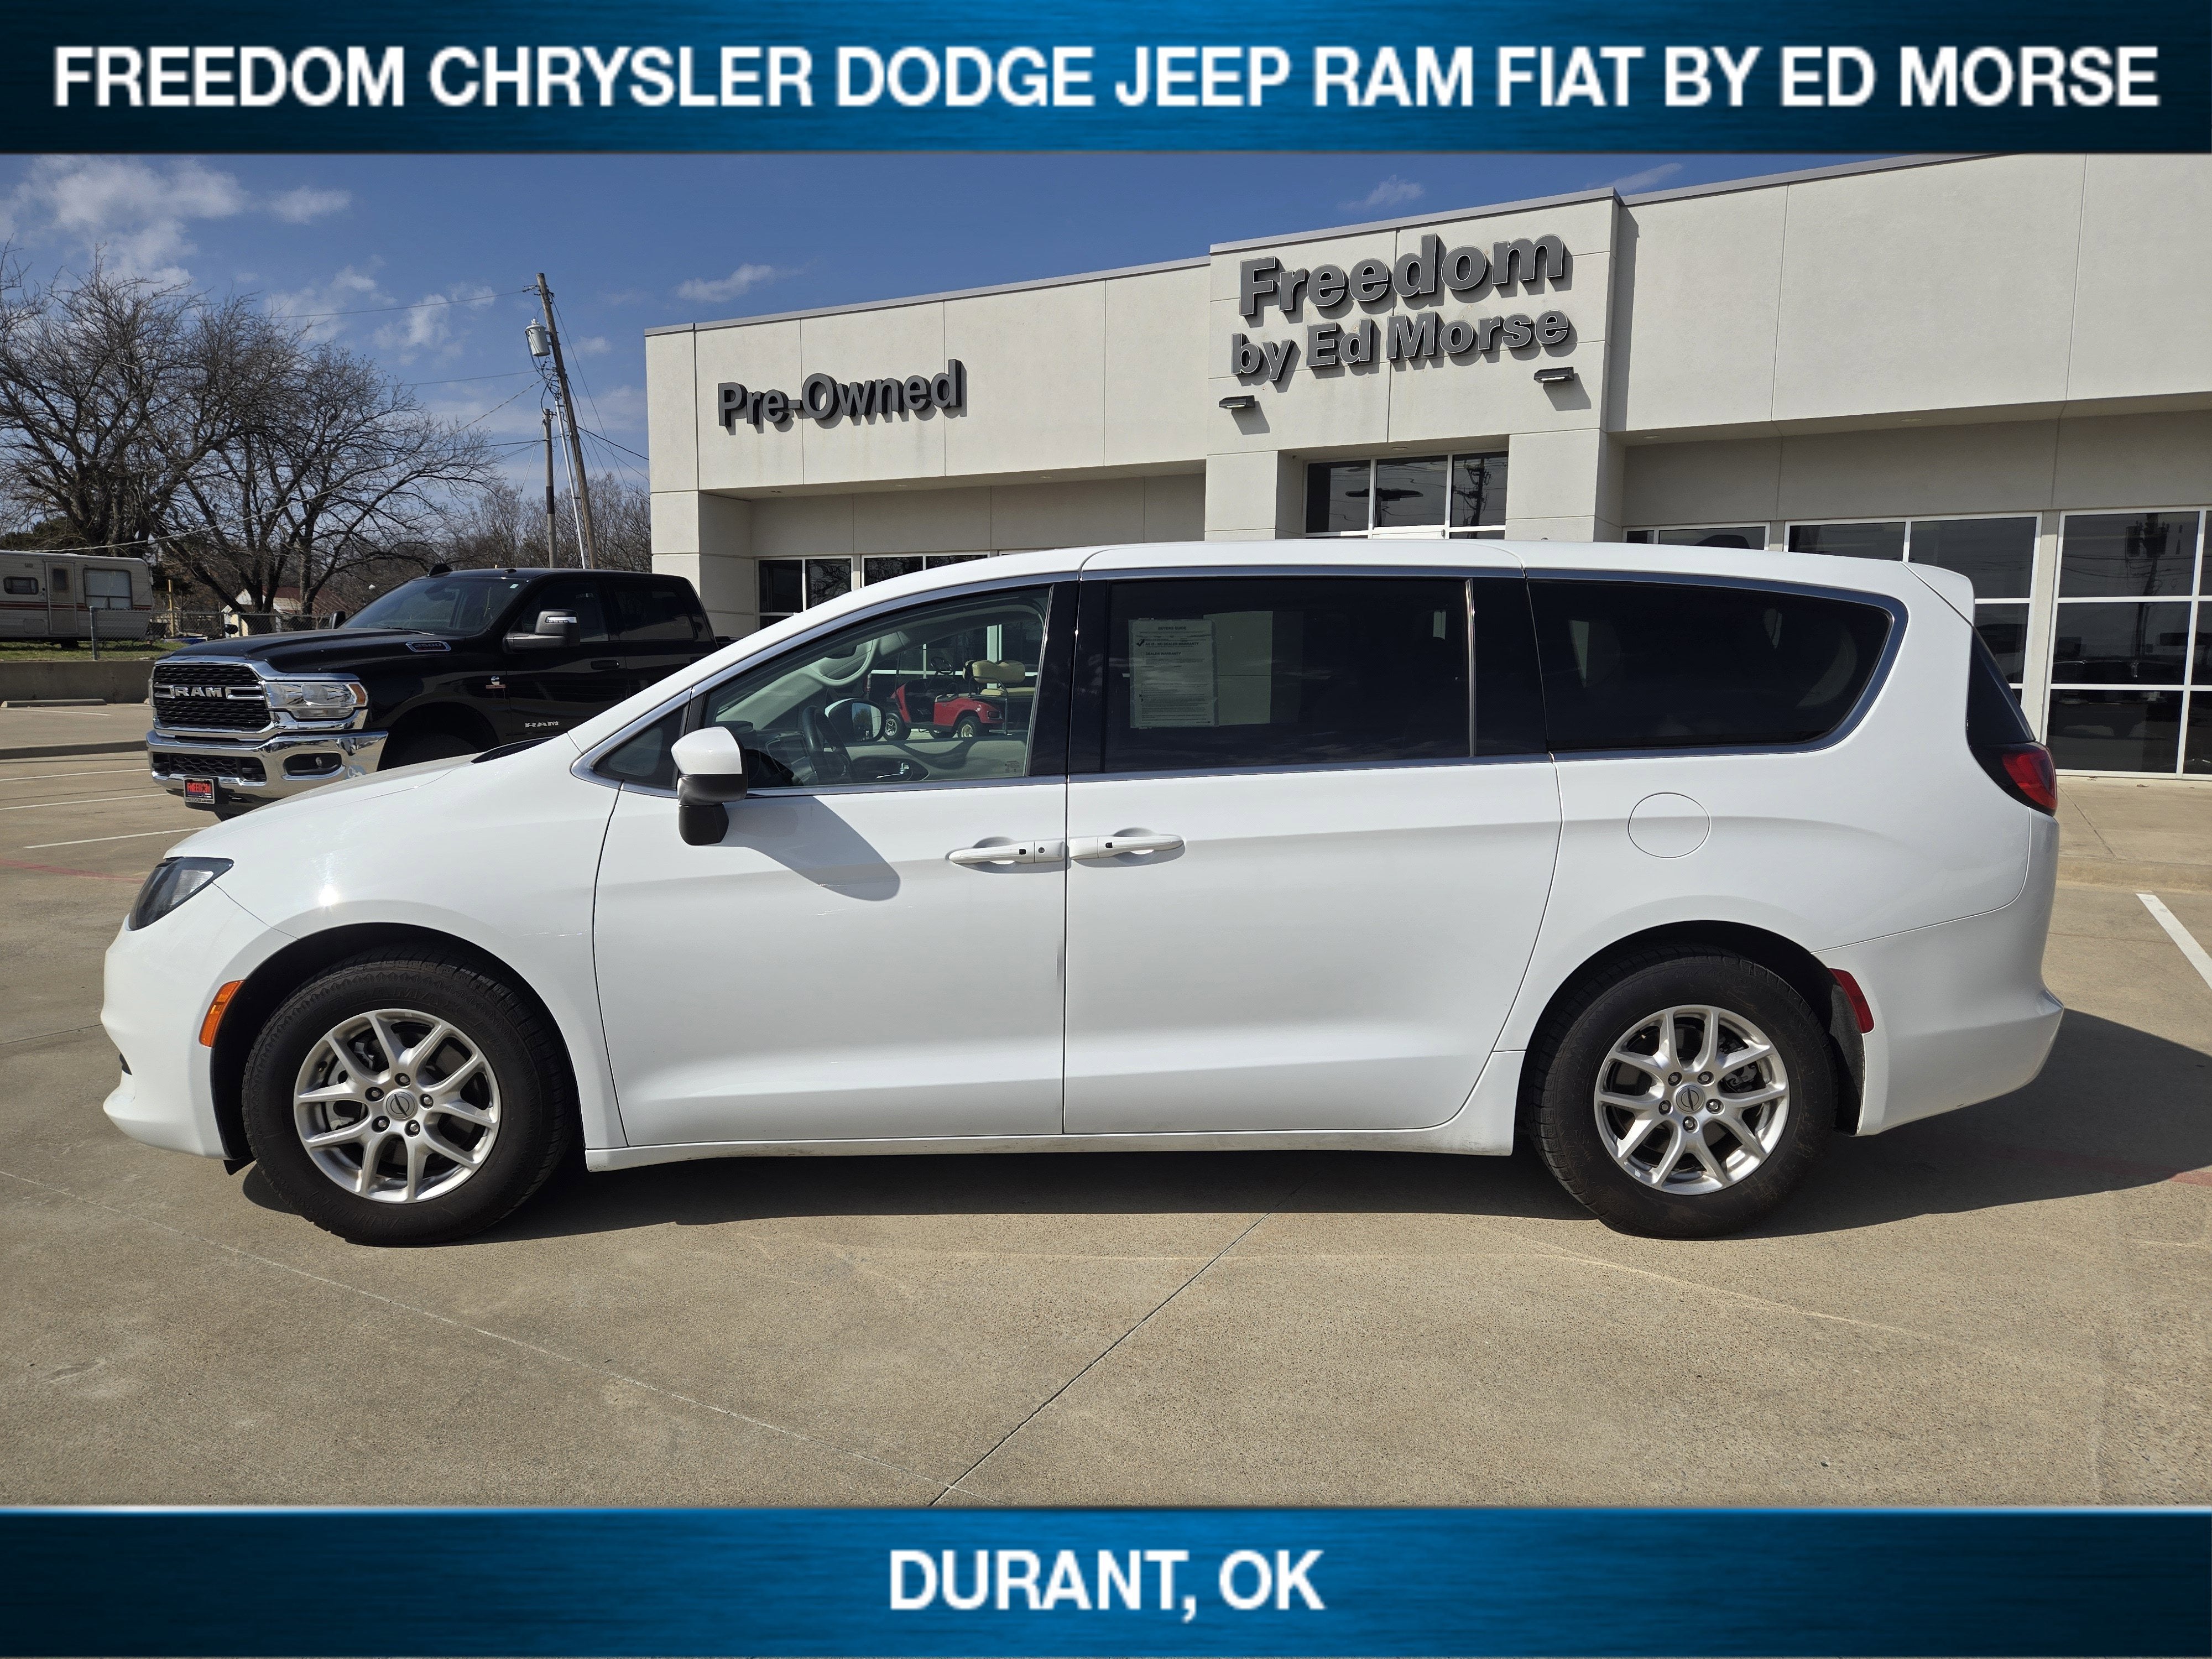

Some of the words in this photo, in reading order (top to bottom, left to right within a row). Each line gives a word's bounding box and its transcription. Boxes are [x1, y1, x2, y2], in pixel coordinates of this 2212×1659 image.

[1239, 233, 1567, 316] Freedom
[1231, 332, 1292, 382] by
[1307, 318, 1374, 367] Ed
[1386, 309, 1570, 359] Morse
[718, 359, 965, 426] Pre-Owned
[175, 687, 222, 697] RAM
